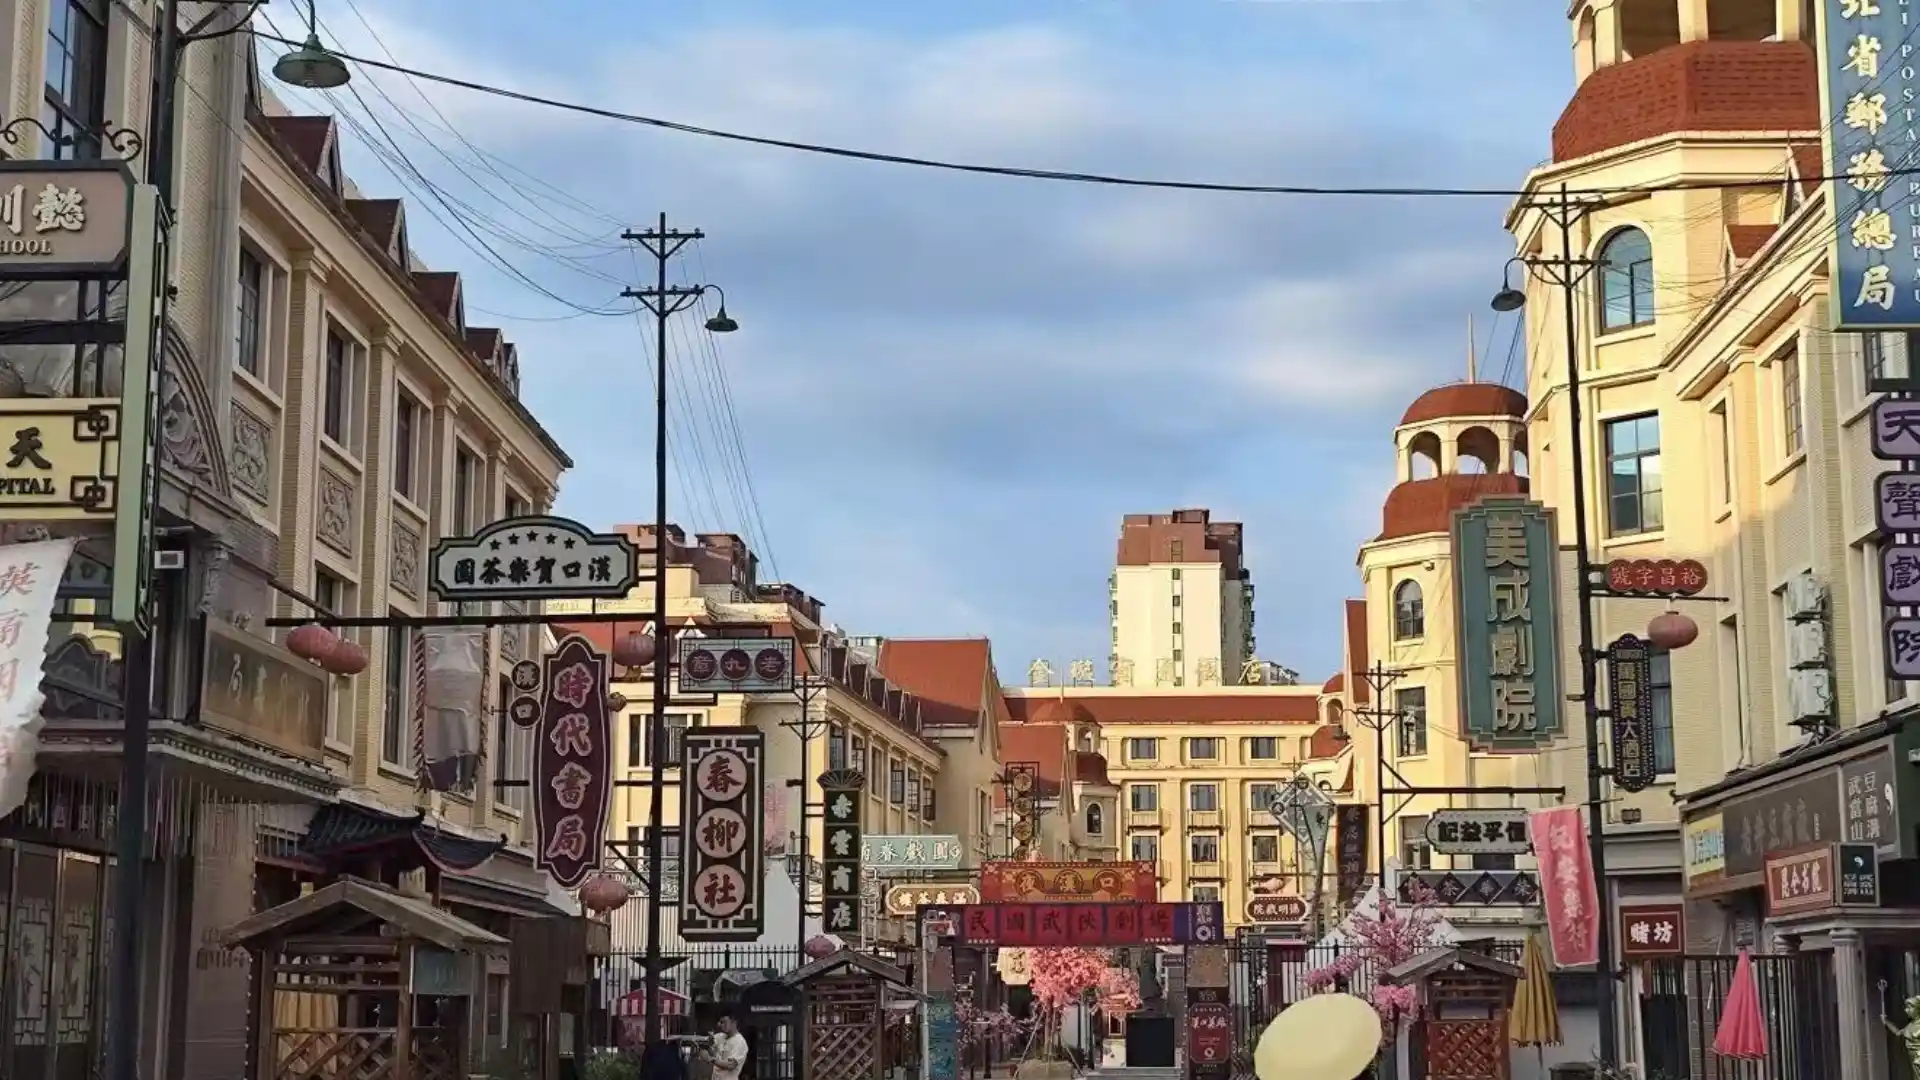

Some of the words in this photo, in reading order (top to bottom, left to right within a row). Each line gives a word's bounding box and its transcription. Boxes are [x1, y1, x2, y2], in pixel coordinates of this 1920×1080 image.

[702, 756, 742, 909] 春柳社
[1630, 921, 1674, 944] 賭坊
